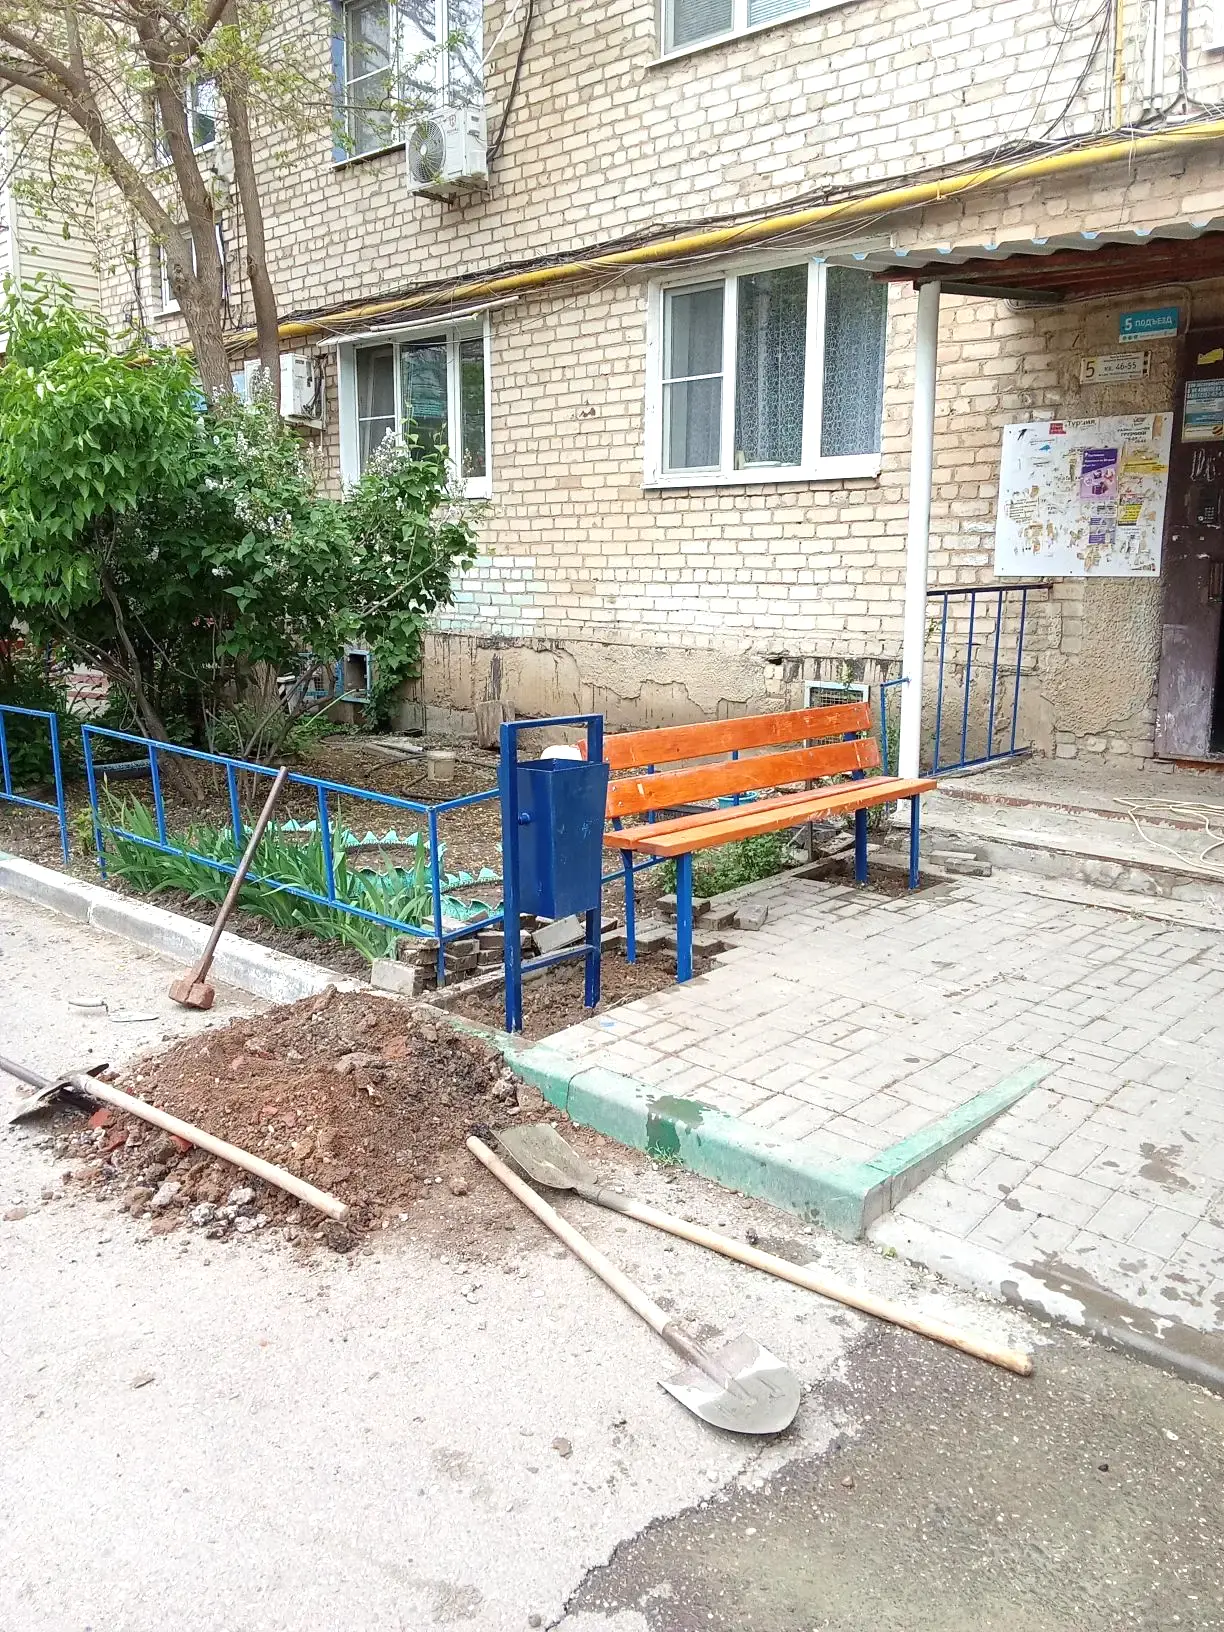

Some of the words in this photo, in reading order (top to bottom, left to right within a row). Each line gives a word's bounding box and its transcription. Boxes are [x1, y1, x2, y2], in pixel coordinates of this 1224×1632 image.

[1124, 317, 1133, 331] 5
[1135, 316, 1173, 328] ПОДЪЕЗД
[1085, 360, 1095, 378] 5
[1115, 361, 1137, 371] 46-55
